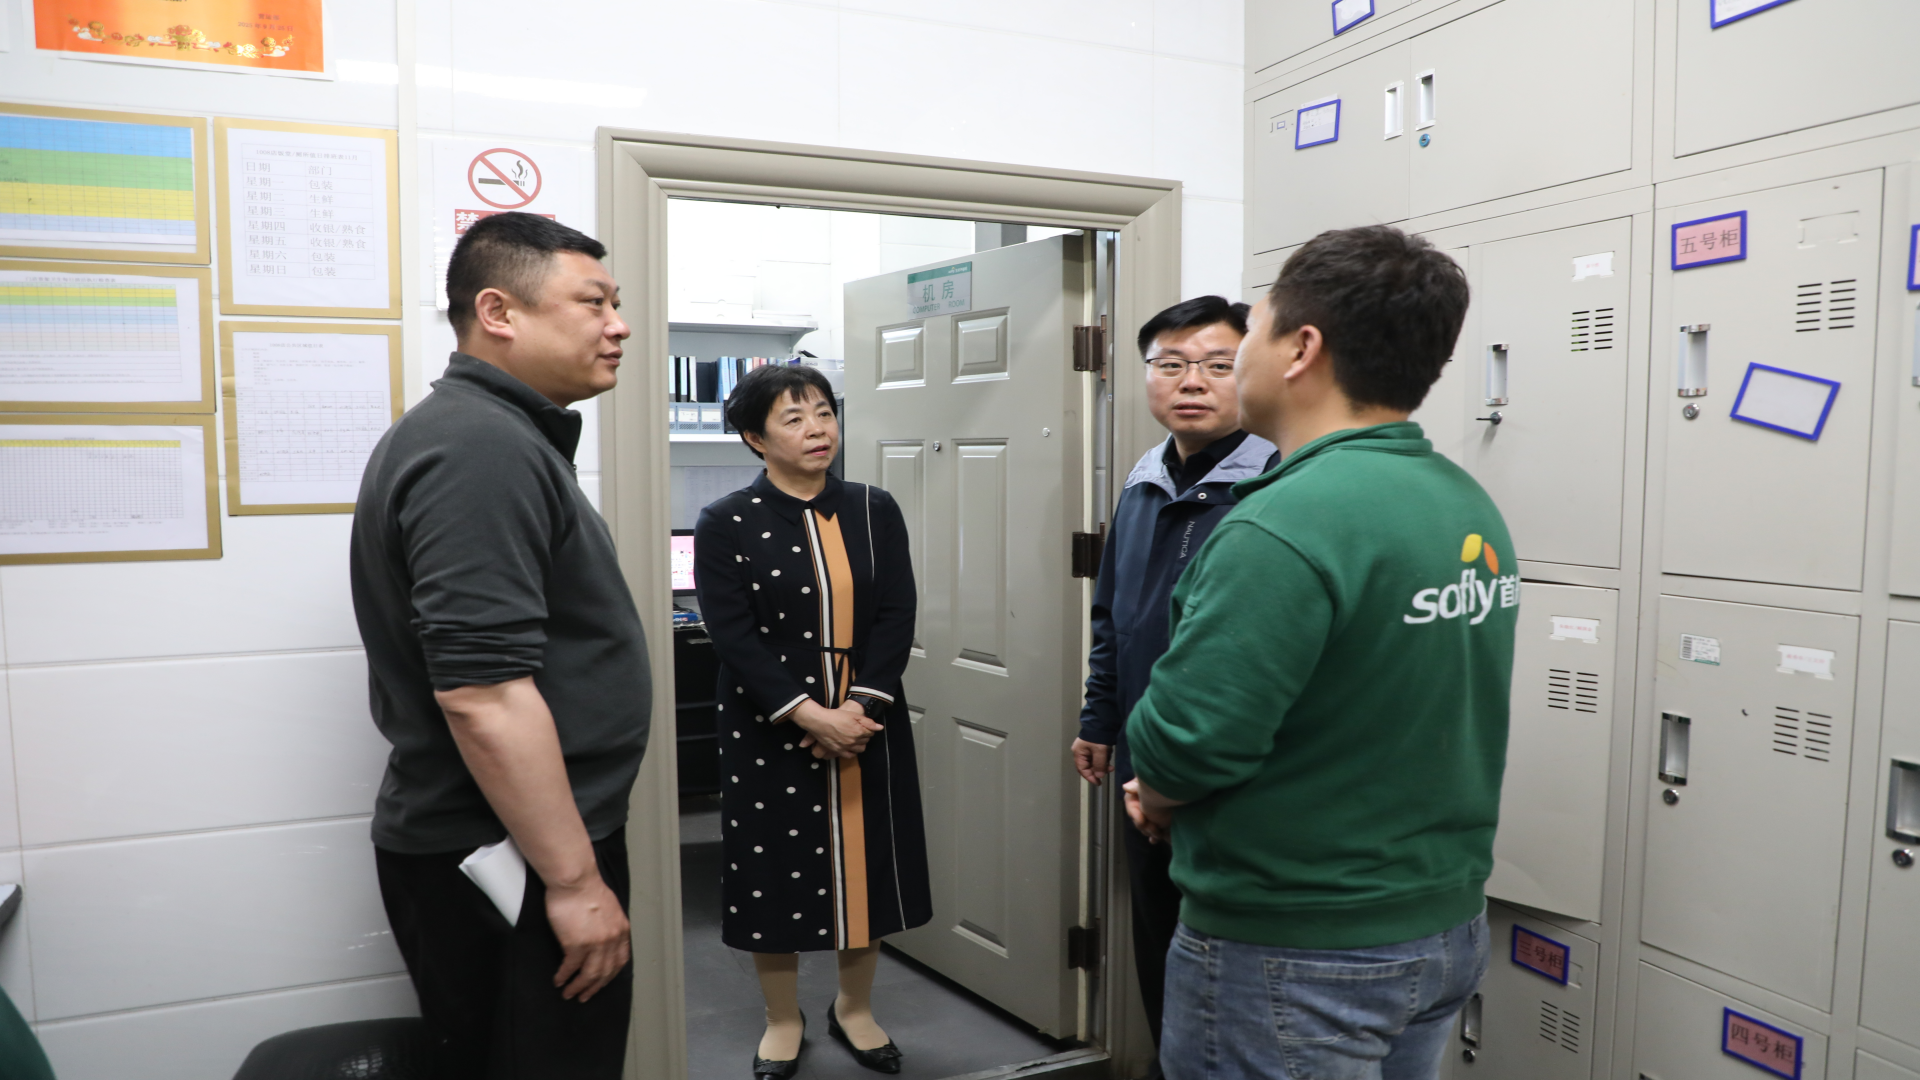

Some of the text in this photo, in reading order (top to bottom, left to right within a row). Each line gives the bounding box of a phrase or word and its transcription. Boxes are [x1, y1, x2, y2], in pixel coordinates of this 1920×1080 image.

[246, 161, 333, 176] 日期 部门
[246, 176, 334, 190] 星期一 包装
[247, 190, 334, 205] 星期二 生鲜
[247, 205, 335, 219] 星期三 生鲜
[248, 220, 366, 235] 星期四 收银/熟食
[249, 234, 367, 249] 星期五 收银/熟食
[1679, 228, 1740, 255] 五号柜
[249, 249, 336, 263] 星期六 包装
[250, 263, 337, 277] 星期日 包装
[922, 280, 955, 303] 机房
[912, 299, 966, 315] COMPUTER ROOM
[1180, 520, 1196, 559] NAUTICA
[1517, 940, 1564, 971] 三号柜
[1731, 1022, 1794, 1064] 四号柜
